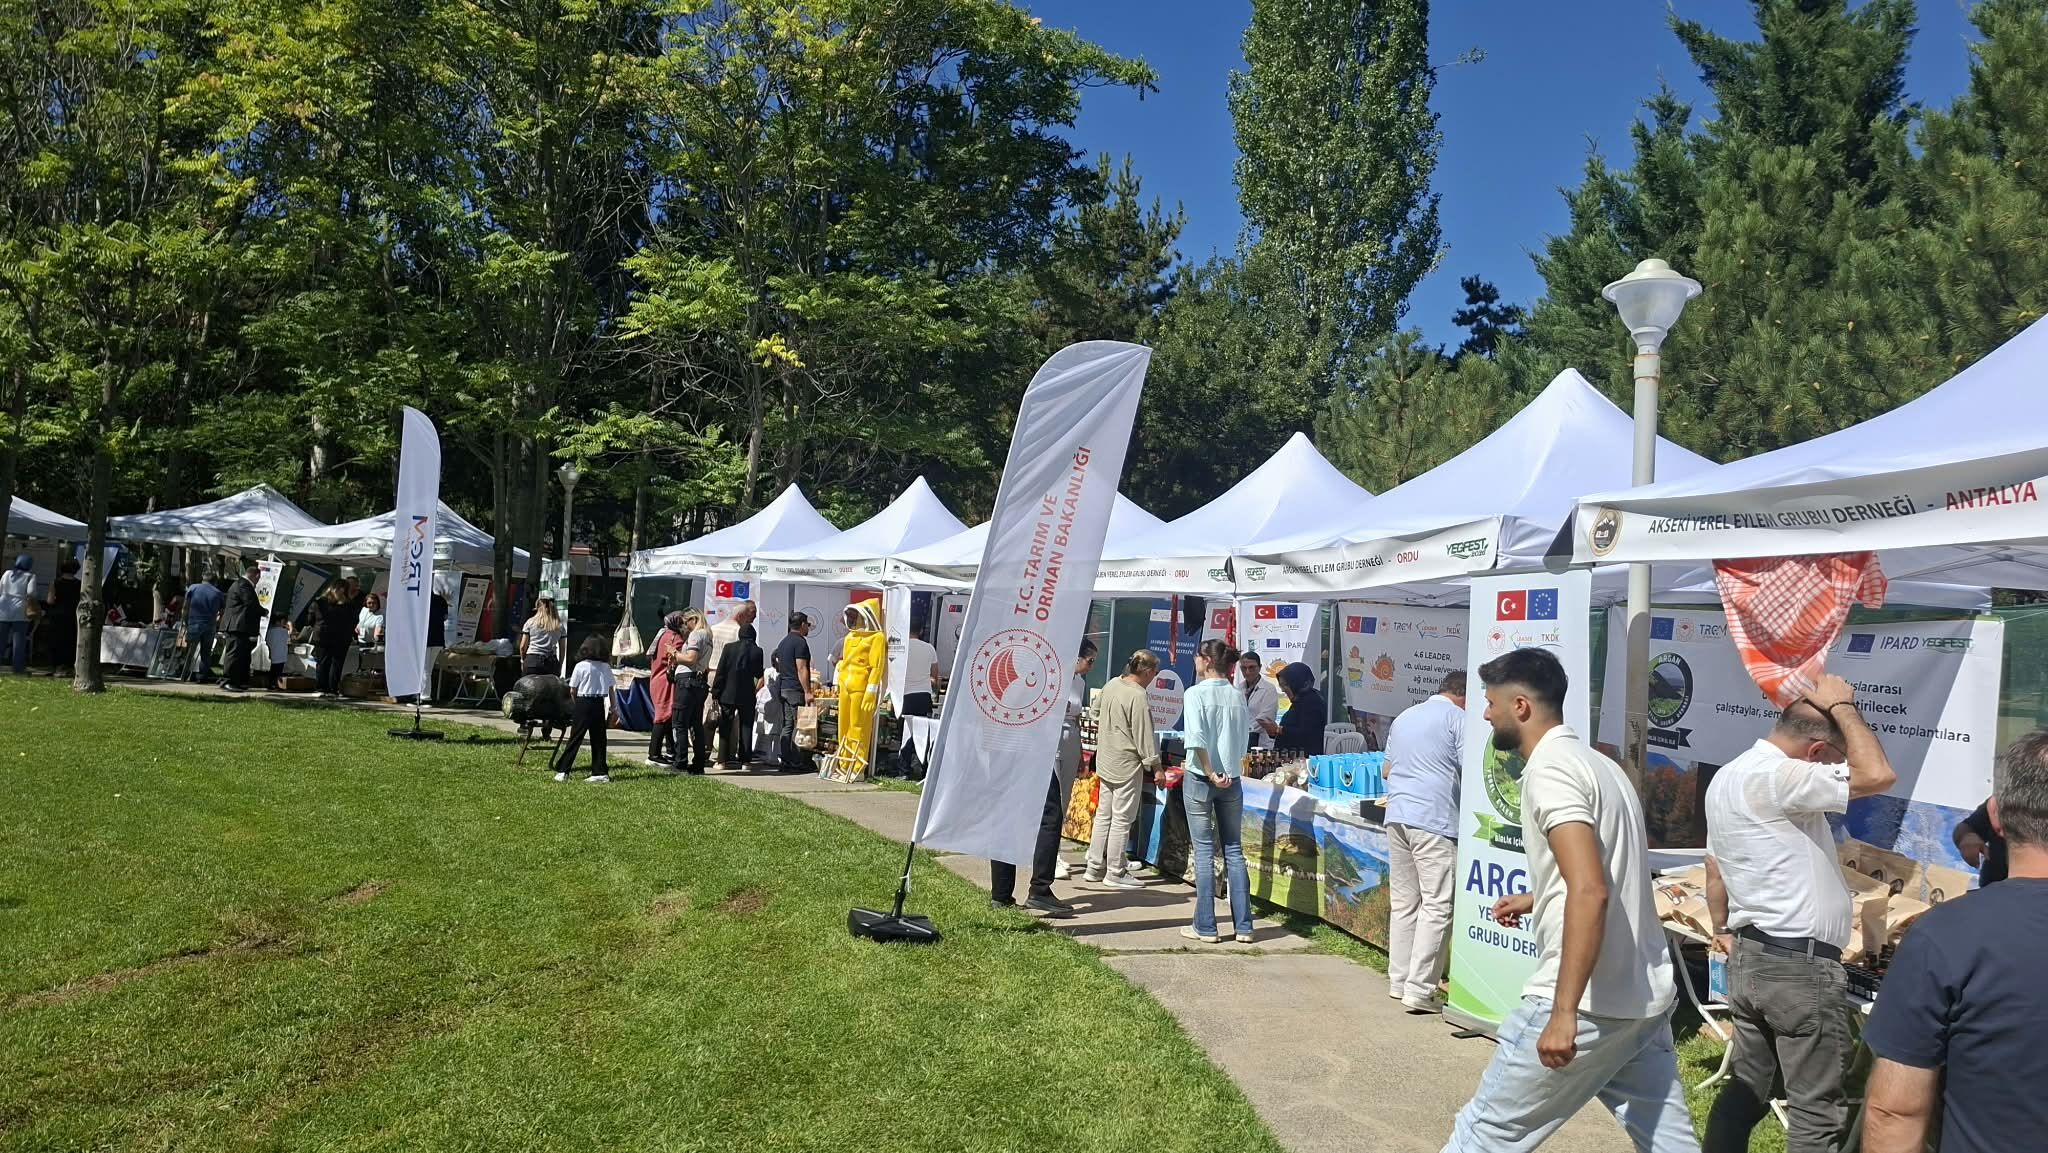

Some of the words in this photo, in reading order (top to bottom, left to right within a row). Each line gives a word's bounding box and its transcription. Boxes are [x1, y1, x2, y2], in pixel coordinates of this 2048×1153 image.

[1040, 493, 1058, 517] VE
[1648, 511, 1692, 534] AKSEKİ
[1692, 512, 1730, 532] YEREL
[1733, 511, 1776, 530] EYLEM
[1778, 508, 1830, 527] GRUBU
[1832, 493, 1917, 524] DERNEĞİ
[1945, 482, 2038, 512] ANTALYA
[1035, 550, 1064, 622] ORMAN
[1054, 446, 1091, 548] BAKANLIĞI
[1023, 521, 1051, 579] TARIM
[1446, 537, 1489, 556] YEGFEST
[1313, 561, 1335, 574] EYLEM
[1336, 560, 1355, 572] GRUBU
[1355, 554, 1384, 571] DERNEĞİ
[1397, 550, 1419, 564] ORDU
[1174, 569, 1190, 578] ORDU
[1014, 585, 1035, 615] T.C.
[1541, 633, 1560, 642] TKDK
[1880, 636, 1919, 650] IPARD
[1424, 651, 1452, 662] LEADER,
[1658, 654, 1681, 667] ARGAN
[1414, 662, 1434, 672] ulusal
[1407, 685, 1429, 696] katılım
[1846, 679, 1903, 696] slararası
[1715, 702, 1762, 719] çalıştaylar,
[1855, 701, 1908, 716] tirilecek
[1881, 724, 1897, 734] ve
[1899, 724, 1971, 743] toplantılara
[1468, 925, 1510, 950] GRUBU
